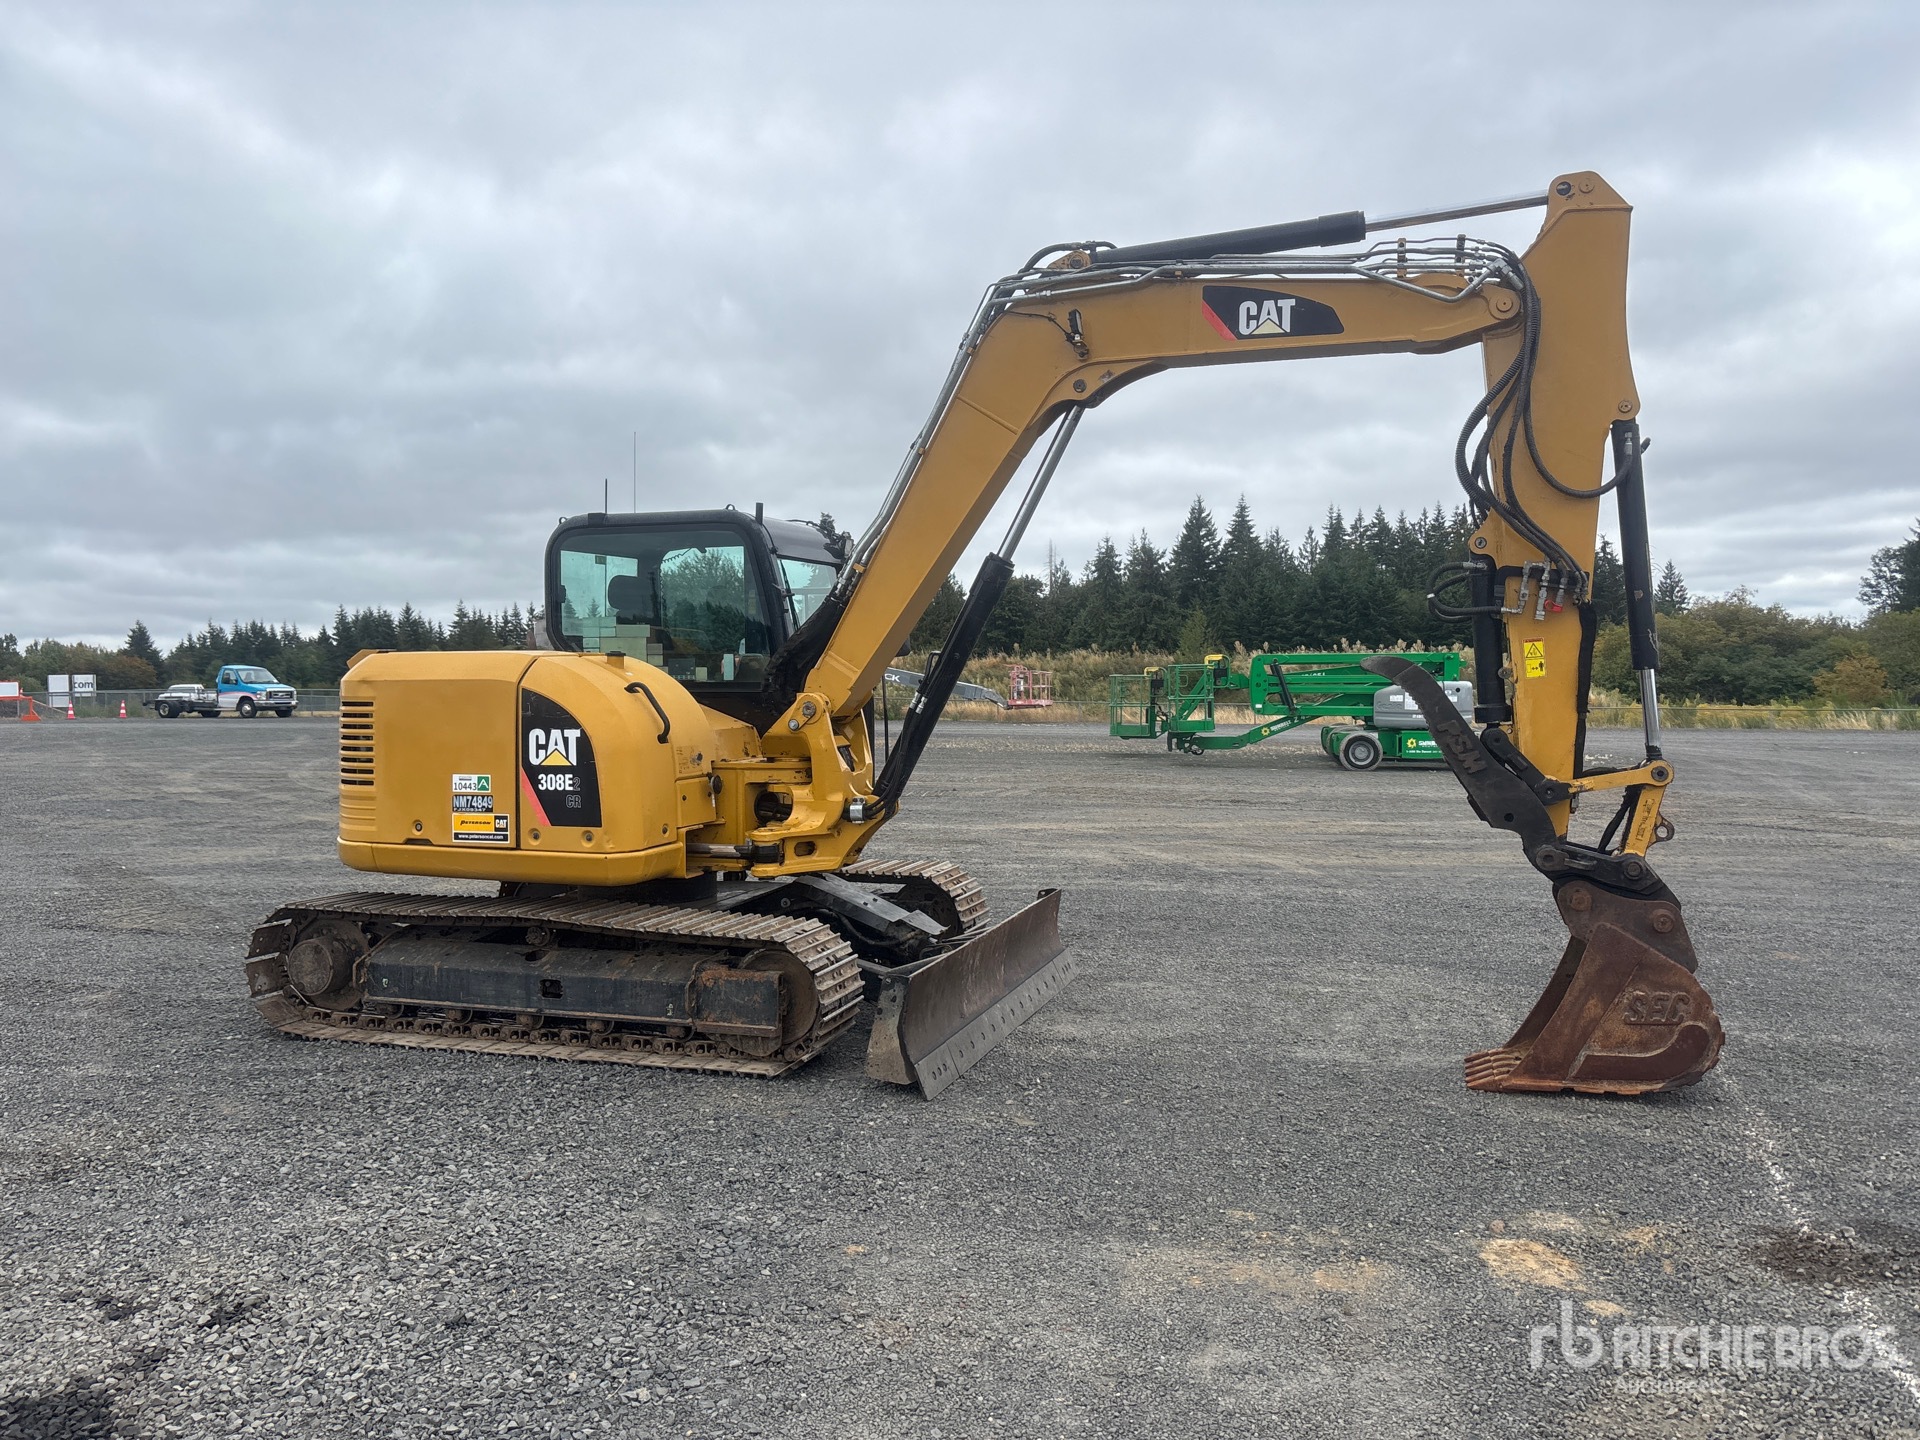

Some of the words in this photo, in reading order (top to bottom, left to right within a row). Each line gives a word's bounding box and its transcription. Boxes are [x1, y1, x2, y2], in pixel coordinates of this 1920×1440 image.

[1238, 298, 1296, 336] CAT
[528, 728, 581, 766] CAT
[453, 782, 477, 791] 10443
[453, 796, 493, 808] NM74849
[565, 794, 582, 809] CR
[495, 819, 507, 828] CAT
